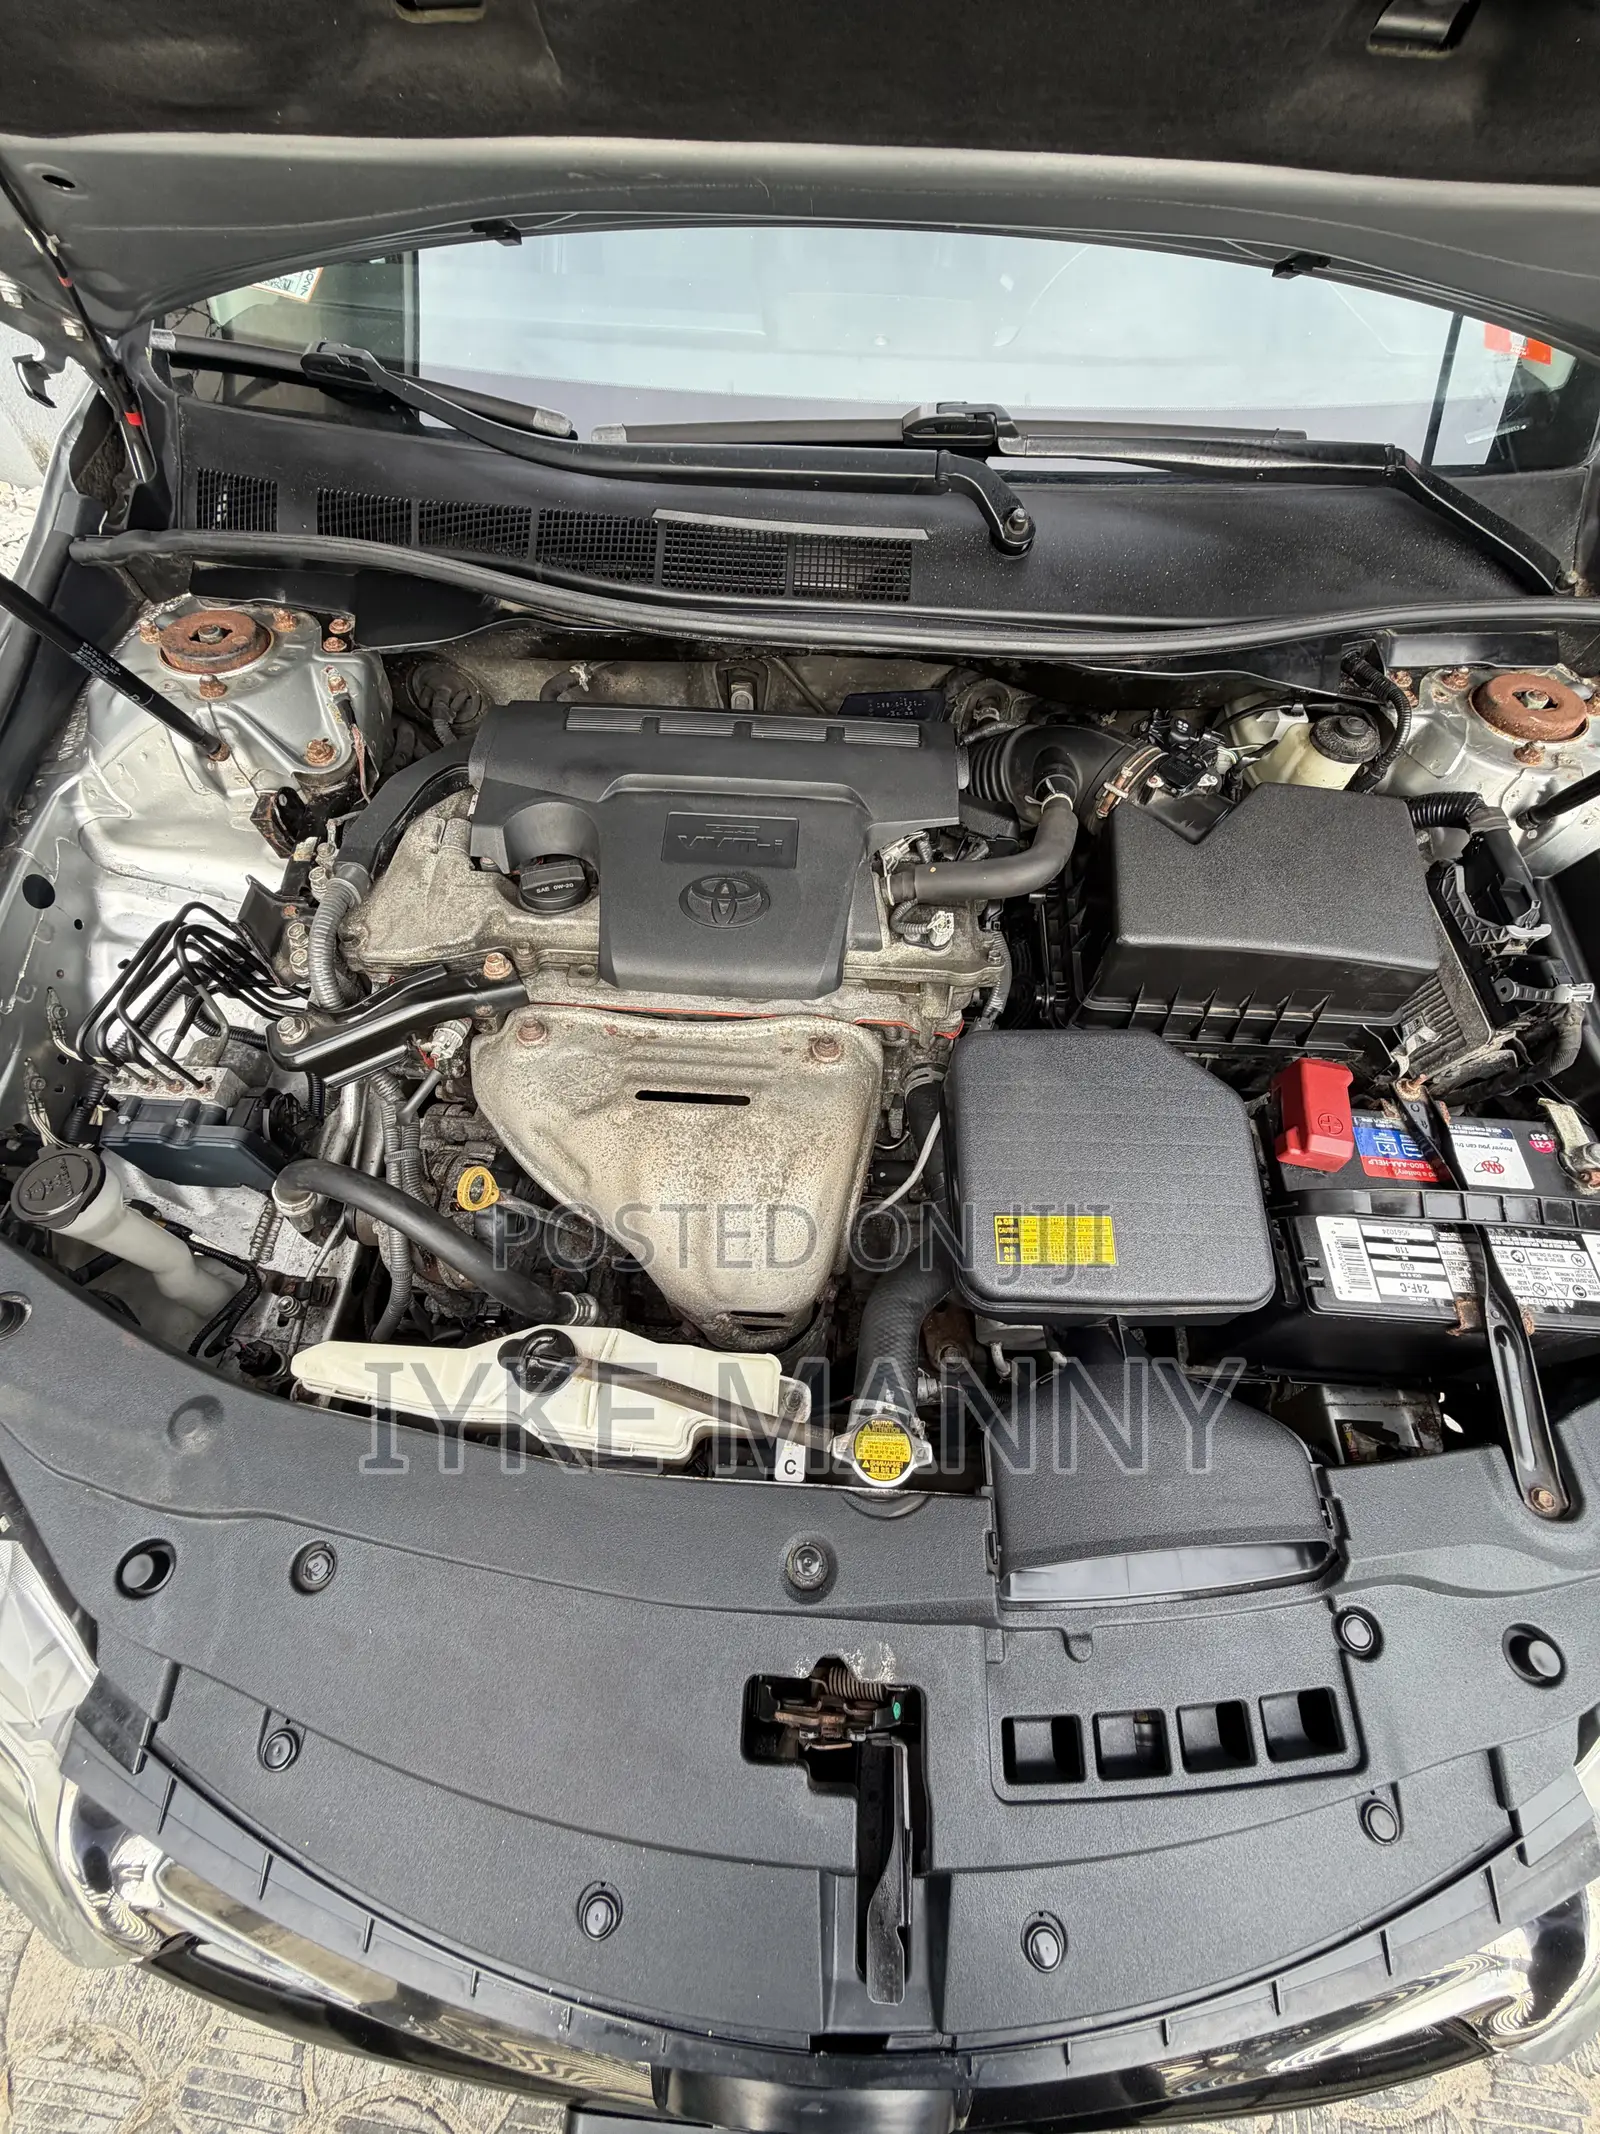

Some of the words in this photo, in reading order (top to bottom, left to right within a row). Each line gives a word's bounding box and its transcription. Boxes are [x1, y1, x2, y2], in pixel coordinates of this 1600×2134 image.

[536, 886, 550, 894] SAE
[553, 882, 574, 890] 0W-20
[1478, 1143, 1491, 1151] you
[1482, 1161, 1503, 1174] AAA
[1395, 1246, 1409, 1254] 110
[1400, 1262, 1415, 1271] 650
[1399, 1282, 1430, 1294] 24F-C
[784, 1459, 797, 1475] C
